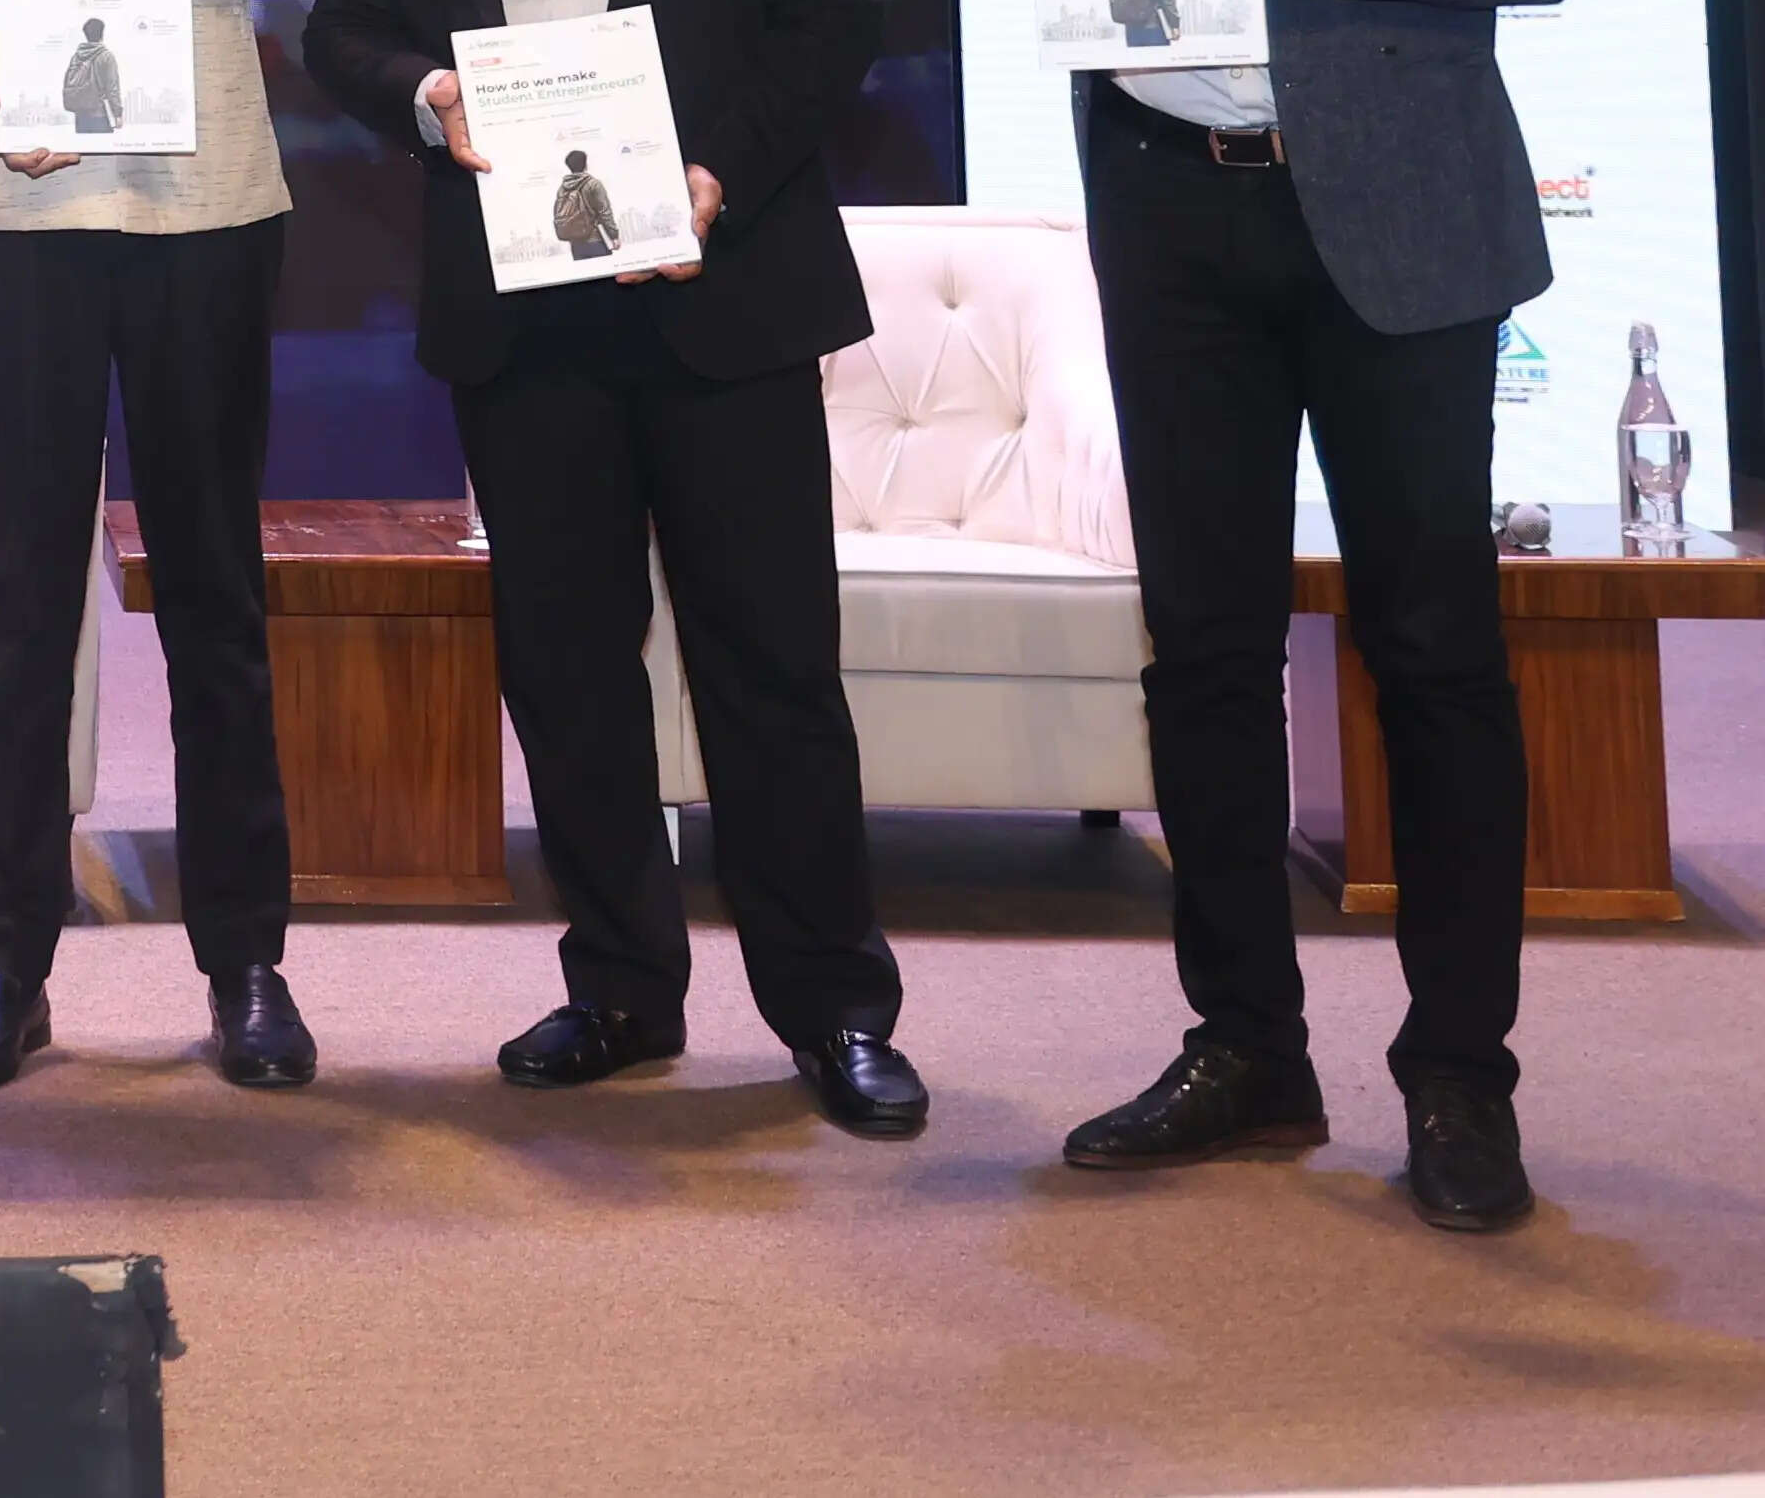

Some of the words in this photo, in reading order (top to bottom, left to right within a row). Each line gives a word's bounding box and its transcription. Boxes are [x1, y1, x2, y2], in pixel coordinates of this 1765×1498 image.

[476, 83, 507, 95] How
[511, 78, 529, 90] do
[533, 77, 554, 86] we
[558, 70, 597, 83] make
[477, 91, 534, 109] Student
